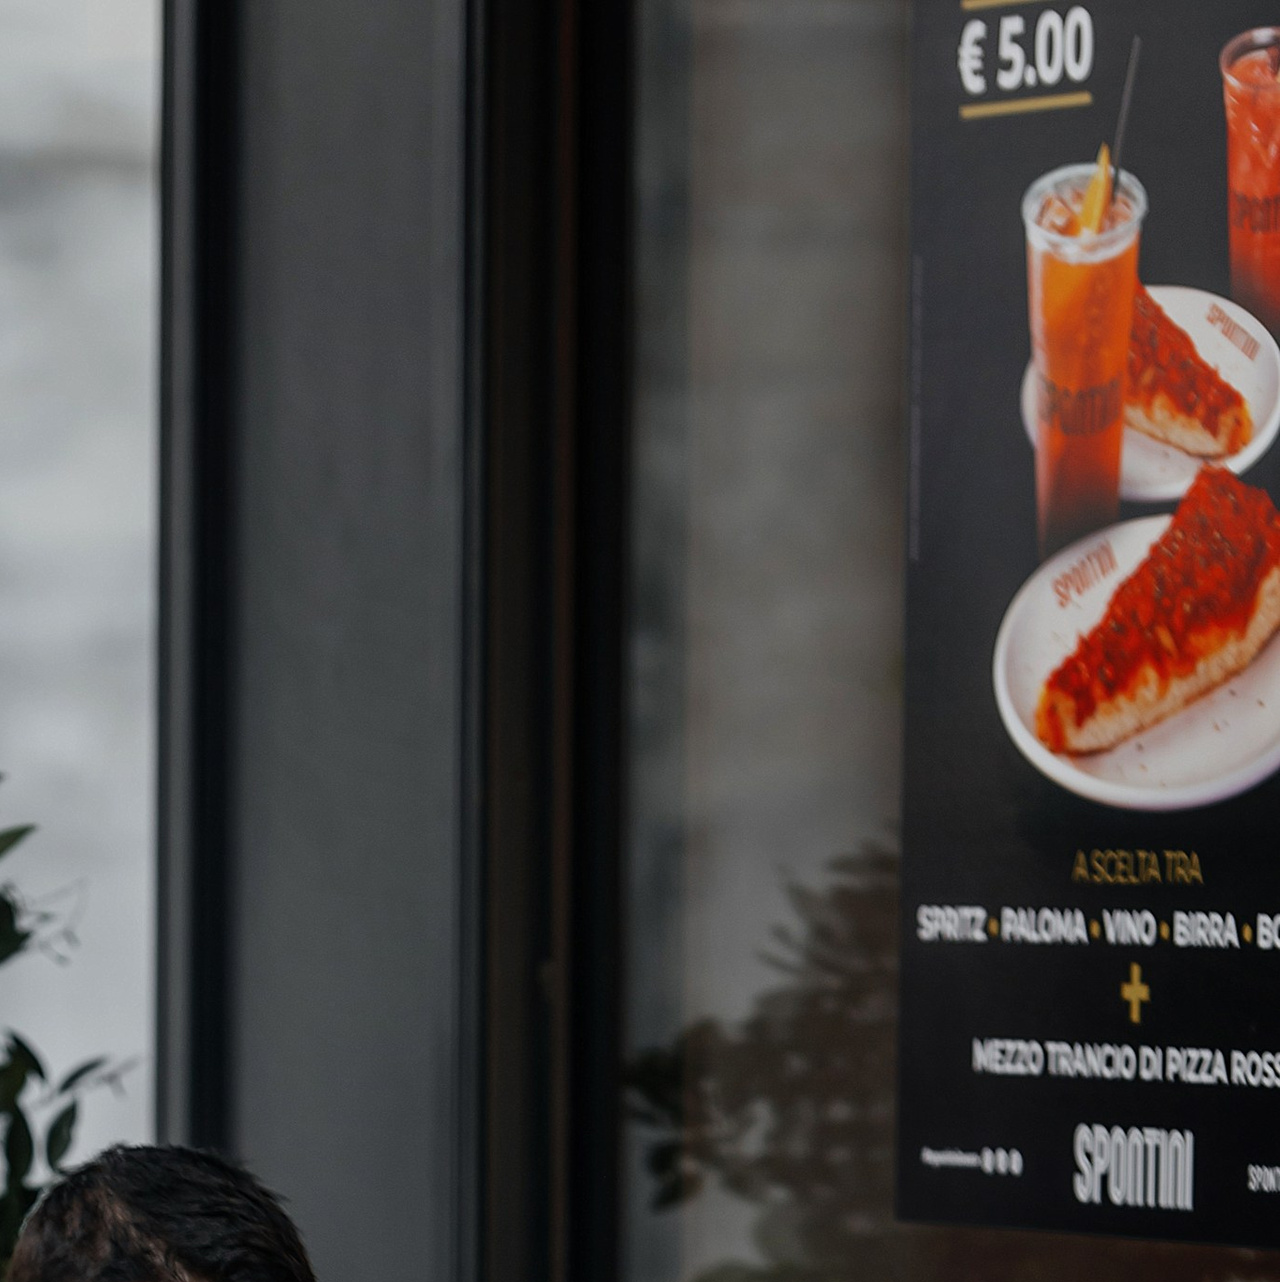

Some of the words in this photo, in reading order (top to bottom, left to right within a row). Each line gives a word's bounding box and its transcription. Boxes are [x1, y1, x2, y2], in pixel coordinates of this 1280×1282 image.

[958, 19, 987, 95] €
[996, 6, 1094, 91] 5.00
[1072, 849, 1089, 882] A
[1090, 849, 1162, 885] SCELTA
[1163, 850, 1204, 885] TRA
[916, 904, 988, 942] SPRITZ
[1000, 906, 1089, 945] PALOMA
[1102, 909, 1157, 946] VINO
[1173, 910, 1241, 949] BIRRA
[972, 1037, 1043, 1075] MEZZO
[1044, 1041, 1136, 1081] TRANCIO
[1139, 1045, 1163, 1081] DI
[1165, 1046, 1229, 1085] PIZZA
[1073, 1122, 1194, 1211] SPONTINI
